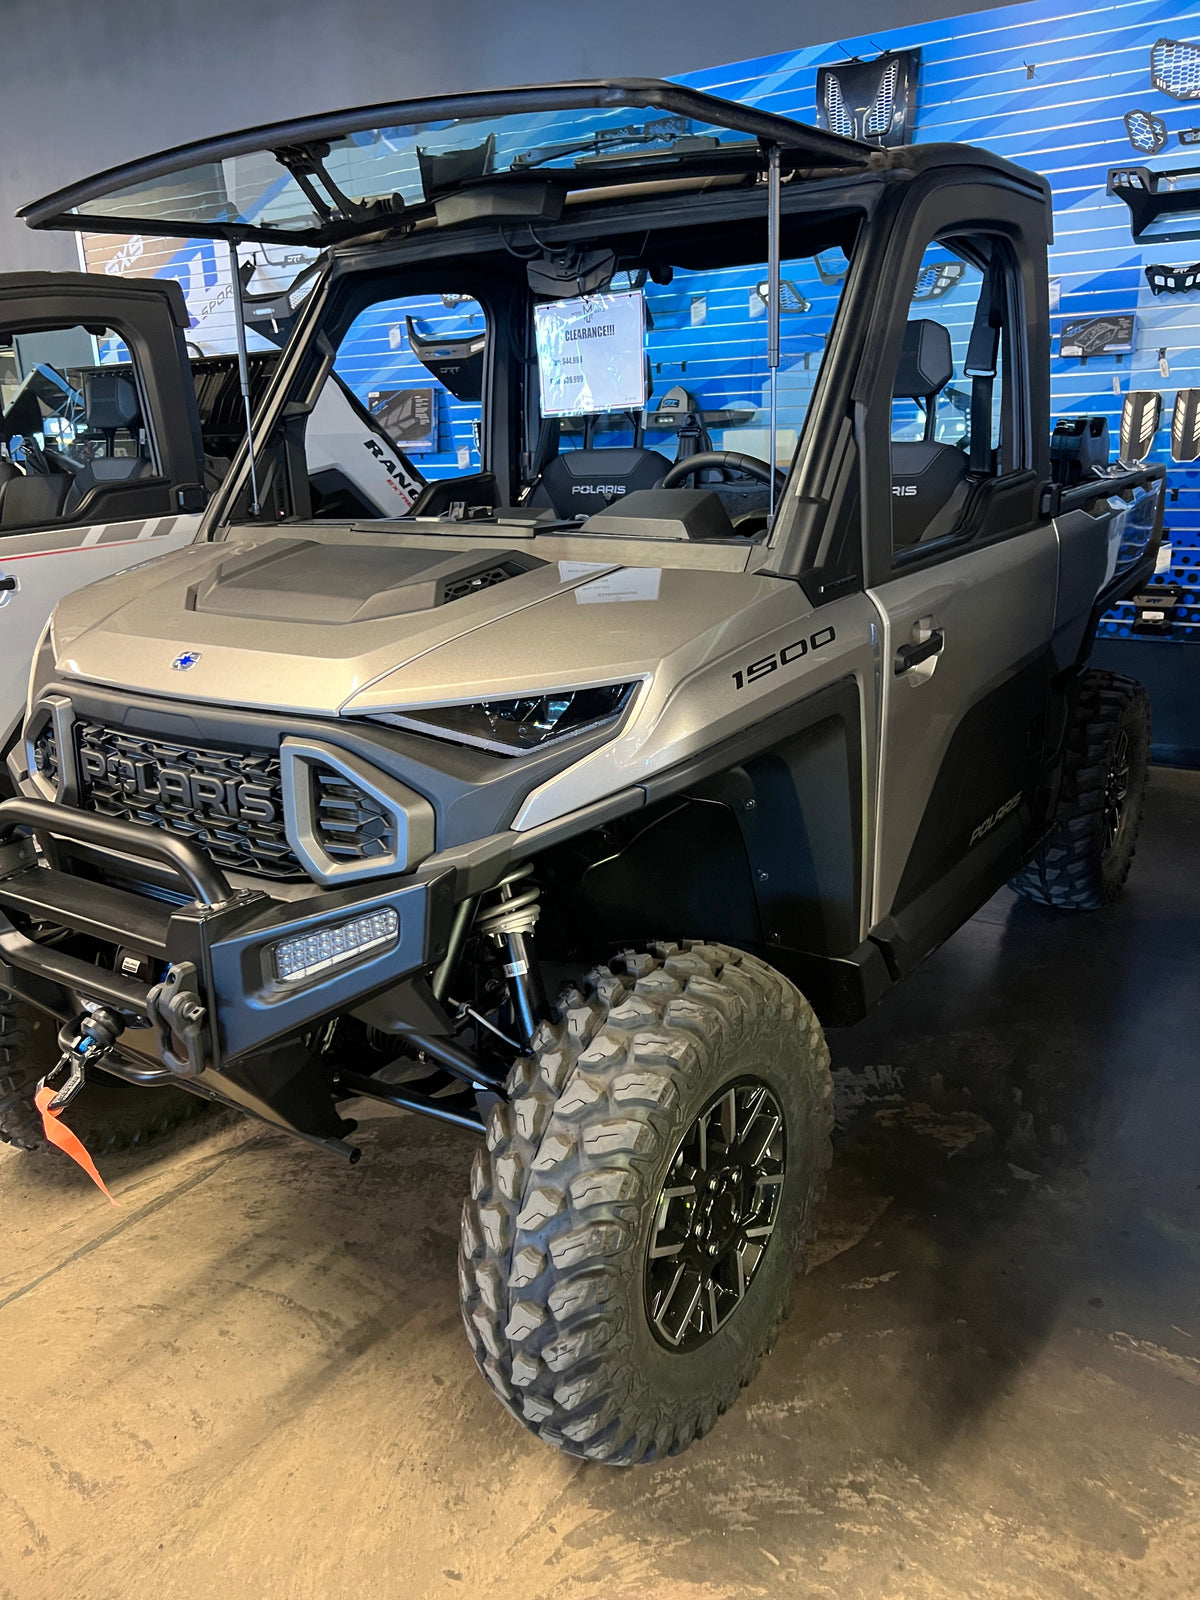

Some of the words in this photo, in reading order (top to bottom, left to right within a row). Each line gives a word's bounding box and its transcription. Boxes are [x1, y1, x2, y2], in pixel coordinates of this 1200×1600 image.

[201, 285, 233, 320] SPOR
[565, 324, 615, 342] CLEARANCE!!!
[363, 439, 420, 501] RANG
[571, 484, 627, 495] POLARIS
[386, 479, 413, 508] EXTRE
[732, 625, 836, 690] 1500
[79, 747, 276, 823] POLARIS
[969, 790, 1023, 847] POLARIS
